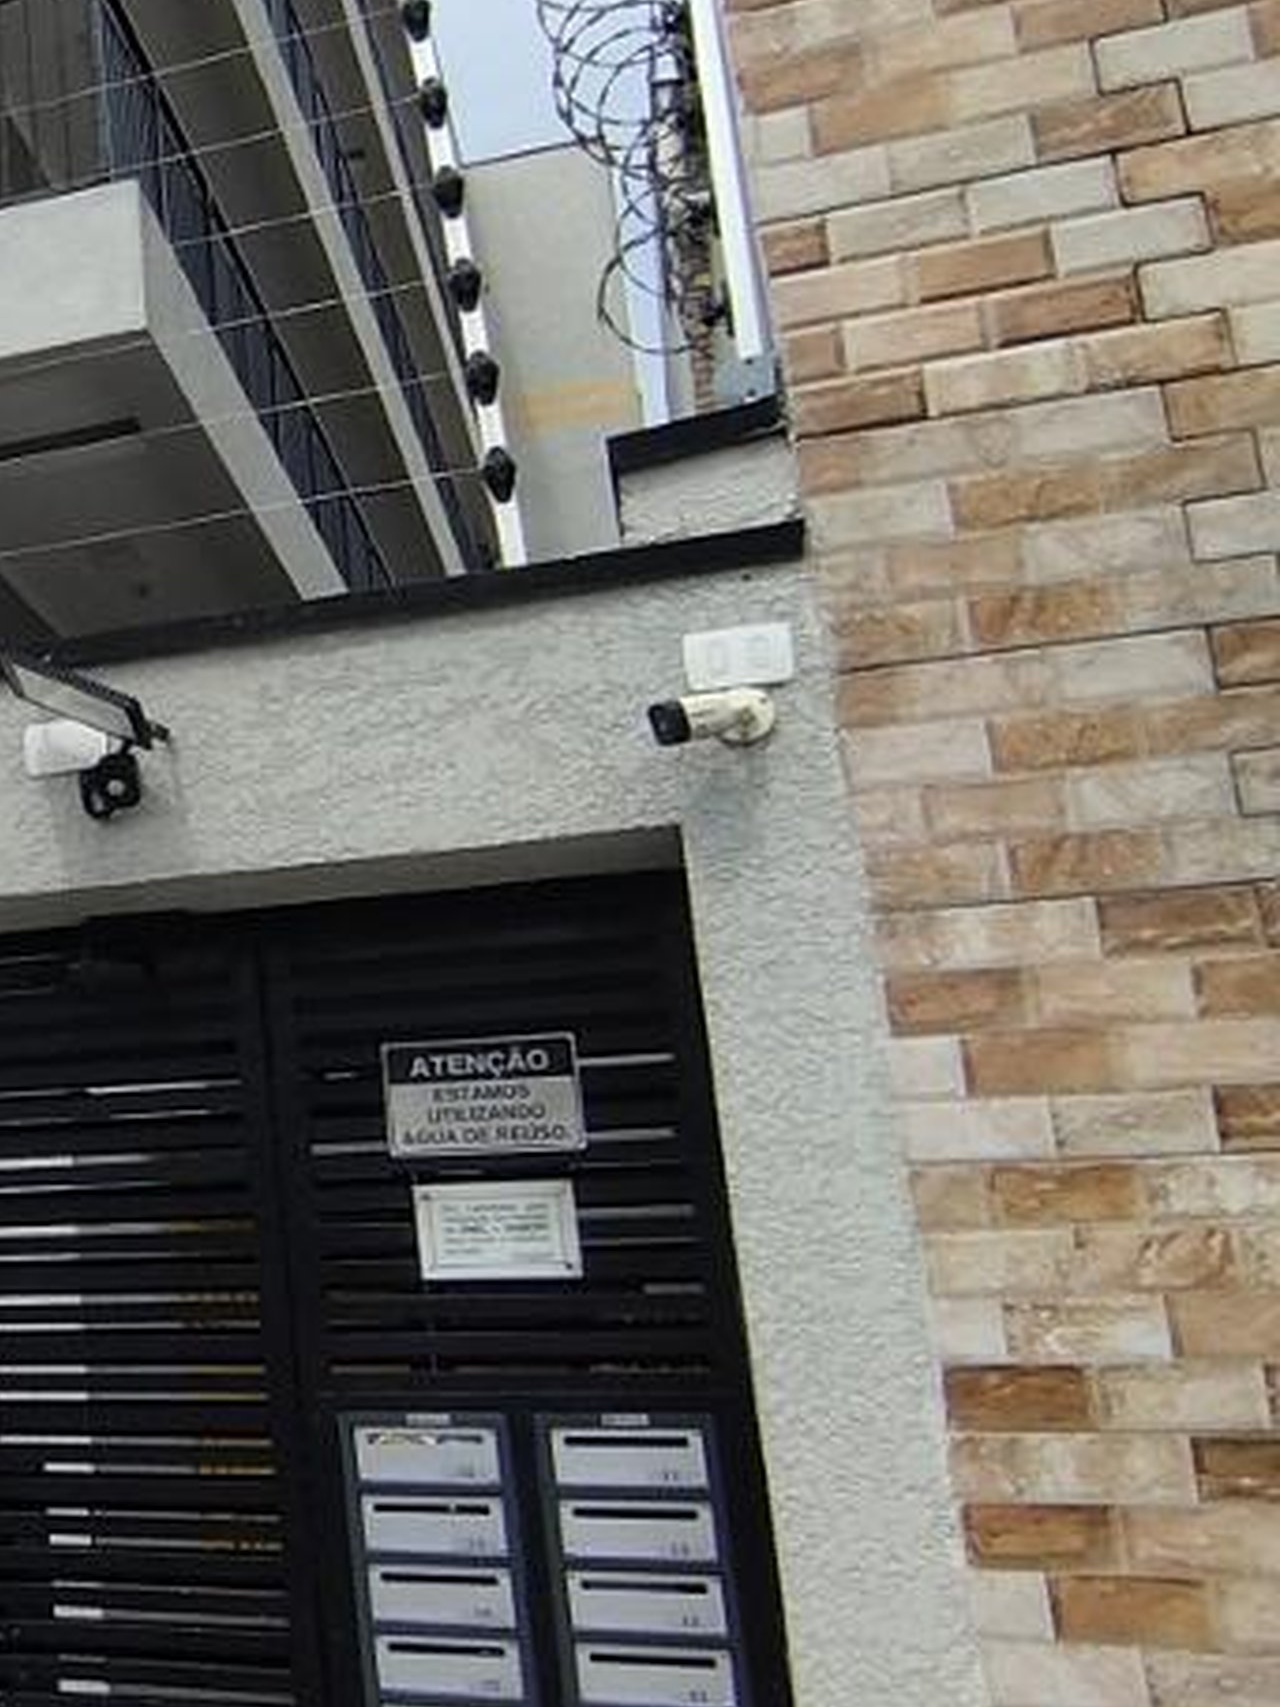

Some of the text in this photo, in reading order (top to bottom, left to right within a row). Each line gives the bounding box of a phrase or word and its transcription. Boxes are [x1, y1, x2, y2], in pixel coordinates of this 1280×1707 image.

[409, 1046, 550, 1078] ATENÇÃO
[431, 1084, 531, 1103] ESTAMOS
[426, 1103, 546, 1124] UTILIZANDO
